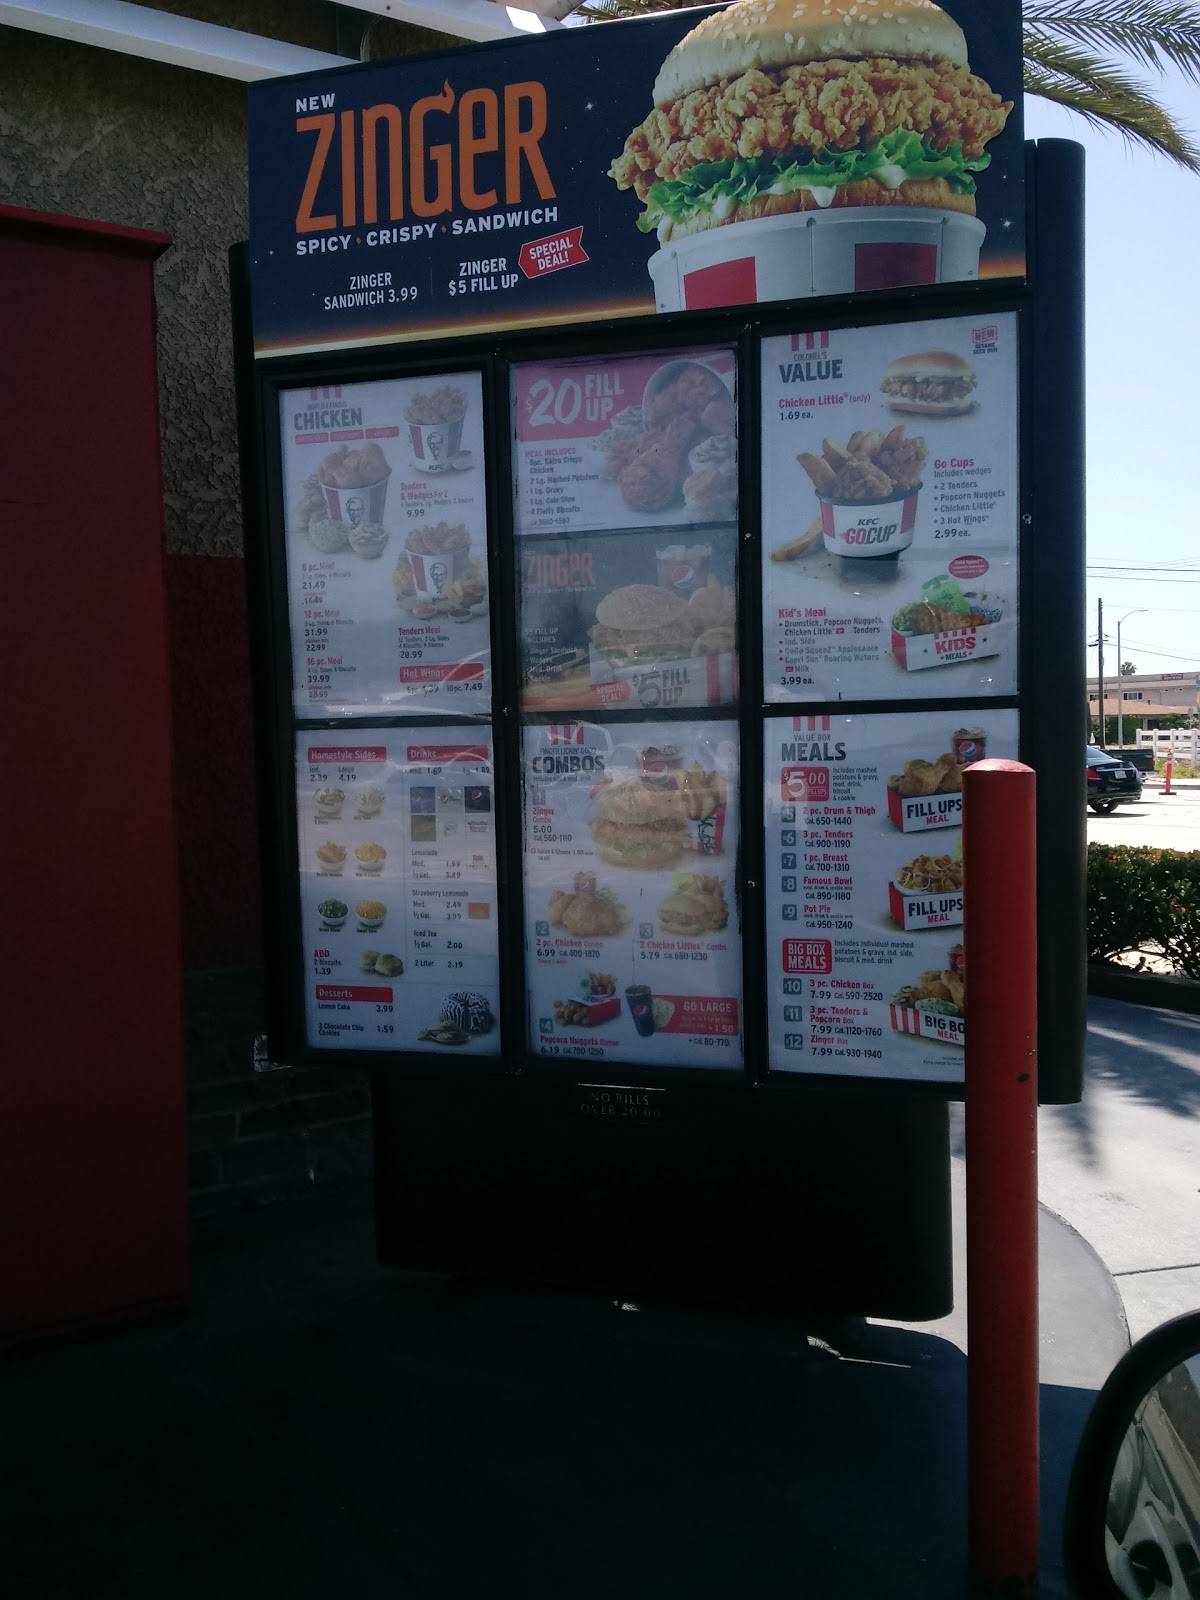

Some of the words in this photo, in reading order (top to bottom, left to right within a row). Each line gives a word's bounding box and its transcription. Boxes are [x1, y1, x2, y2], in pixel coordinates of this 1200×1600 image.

[296, 94, 335, 113] NEW
[295, 80, 556, 234] ZINGER
[296, 235, 352, 257] SPICY
[366, 223, 437, 247] CRISPY
[452, 206, 558, 235] SANDWICH
[529, 238, 573, 261] SPECIAL
[537, 251, 570, 271] DEAL!
[459, 258, 507, 277] ZINGER
[350, 272, 392, 291] ZINGER
[471, 277, 500, 294] FILL
[502, 274, 519, 290] UP
[324, 290, 384, 311] SANDWICH
[387, 287, 418, 304] 3.99
[779, 359, 843, 384] VALUE
[584, 371, 625, 399] FILL
[779, 395, 816, 409] Chicken
[585, 396, 614, 422] UP
[294, 408, 362, 430] CHICKEN
[779, 410, 800, 422] 1.69
[801, 411, 814, 420] ea.
[934, 459, 947, 470] Go
[950, 457, 975, 469] Cups
[934, 469, 962, 479] Includes
[948, 481, 978, 490] Tenders
[940, 493, 972, 502] Popcorn
[974, 489, 1006, 500] Nuggets
[940, 503, 970, 513] Chicken
[858, 518, 881, 527] KFC
[948, 516, 961, 525] Hot
[935, 528, 958, 539] 2.99
[959, 530, 972, 538] ea.
[778, 607, 802, 619] Kid's
[804, 607, 826, 618] Meal
[824, 617, 852, 627] Popcorn
[784, 628, 812, 637] Chicken
[852, 626, 881, 635] Tenders
[935, 636, 976, 655] KIDS
[945, 651, 968, 662] MEALS
[780, 676, 802, 686] 3.99
[793, 733, 815, 743] VALUE
[780, 742, 847, 762] MEALS
[533, 754, 606, 774] COMBOS
[833, 766, 855, 775] Includes
[824, 806, 844, 816] Drum
[855, 806, 876, 818] Thigh
[907, 802, 937, 819] FILL
[939, 799, 963, 815] UPS
[816, 816, 853, 826] 650-1440
[926, 815, 950, 826] MEAL
[534, 825, 552, 834] 5.00
[810, 831, 822, 841] pc.
[825, 830, 853, 840] Tenders
[816, 839, 852, 849] 900-1190
[809, 853, 821, 864] pc.
[823, 853, 848, 863] Breast
[816, 862, 851, 873] 700-1310
[803, 876, 832, 886] Famous
[834, 876, 853, 886] Bowl
[804, 904, 817, 914] Pot
[908, 902, 938, 917] FILL
[940, 898, 964, 914] UPS
[927, 913, 951, 924] MEAL
[816, 920, 853, 931] 950-1240
[314, 949, 330, 958] ADD
[537, 949, 556, 958] 6.99
[787, 943, 804, 956] BIG
[806, 944, 826, 957] BOX
[641, 952, 660, 961] 5.79
[788, 956, 827, 971] MEALS
[817, 980, 829, 991] pc.
[831, 979, 861, 990] Chicken
[319, 989, 352, 999] Desserts
[811, 990, 832, 1001] 7.99
[845, 991, 884, 1002] 590-2520
[376, 1004, 394, 1013] 3.99
[682, 1002, 698, 1012] GO
[700, 1002, 732, 1014] LARGE
[817, 1006, 829, 1017] pc.
[831, 1006, 861, 1016] Tenders
[810, 1014, 841, 1025] Popcorn
[925, 1015, 946, 1031] BIG
[949, 1020, 966, 1034] BO
[811, 1025, 832, 1035] 7.99
[846, 1026, 883, 1037] 1120-1760
[937, 1029, 960, 1042] MEAL
[811, 1047, 833, 1057] 7.99
[846, 1048, 883, 1060] 930-1940
